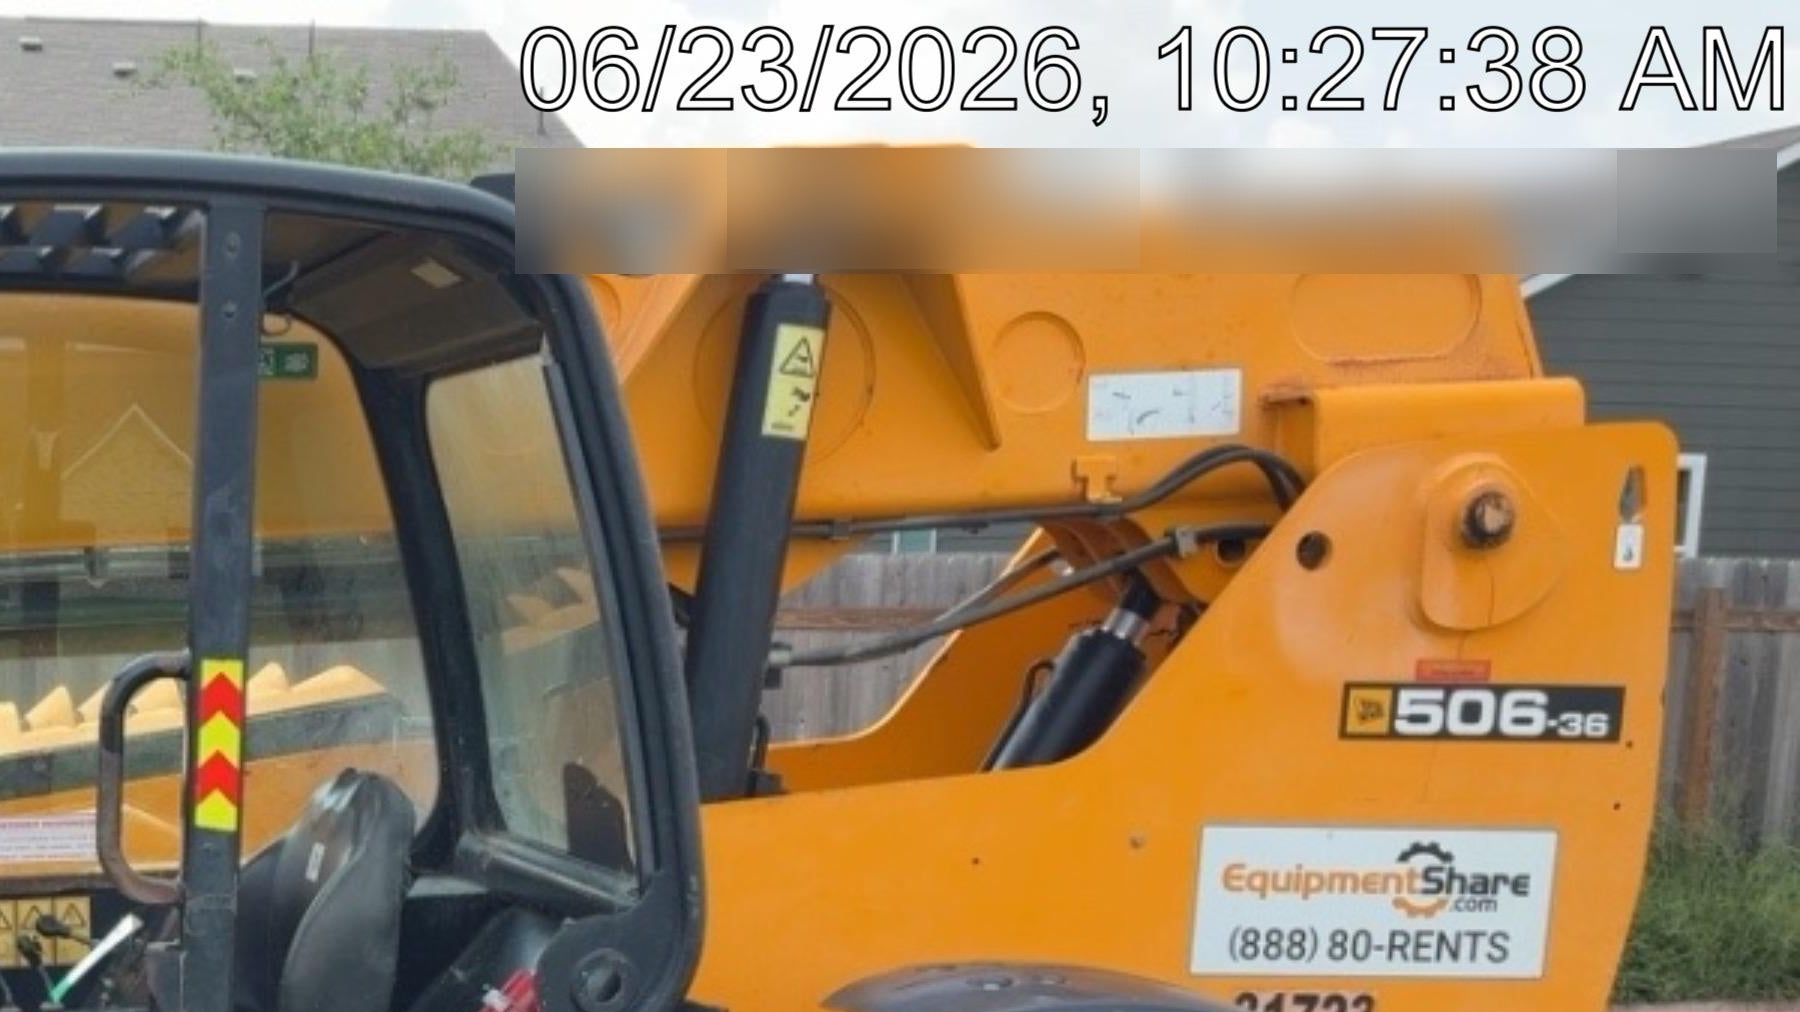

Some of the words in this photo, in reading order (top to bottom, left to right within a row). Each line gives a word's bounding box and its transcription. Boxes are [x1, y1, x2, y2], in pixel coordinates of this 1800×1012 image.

[1394, 687, 1609, 738] 506-36
[1221, 863, 1531, 901] EquipmentShare
[1449, 896, 1498, 913] .com
[1229, 925, 1319, 963] (888)
[1327, 927, 1511, 964] 80-RENTS
